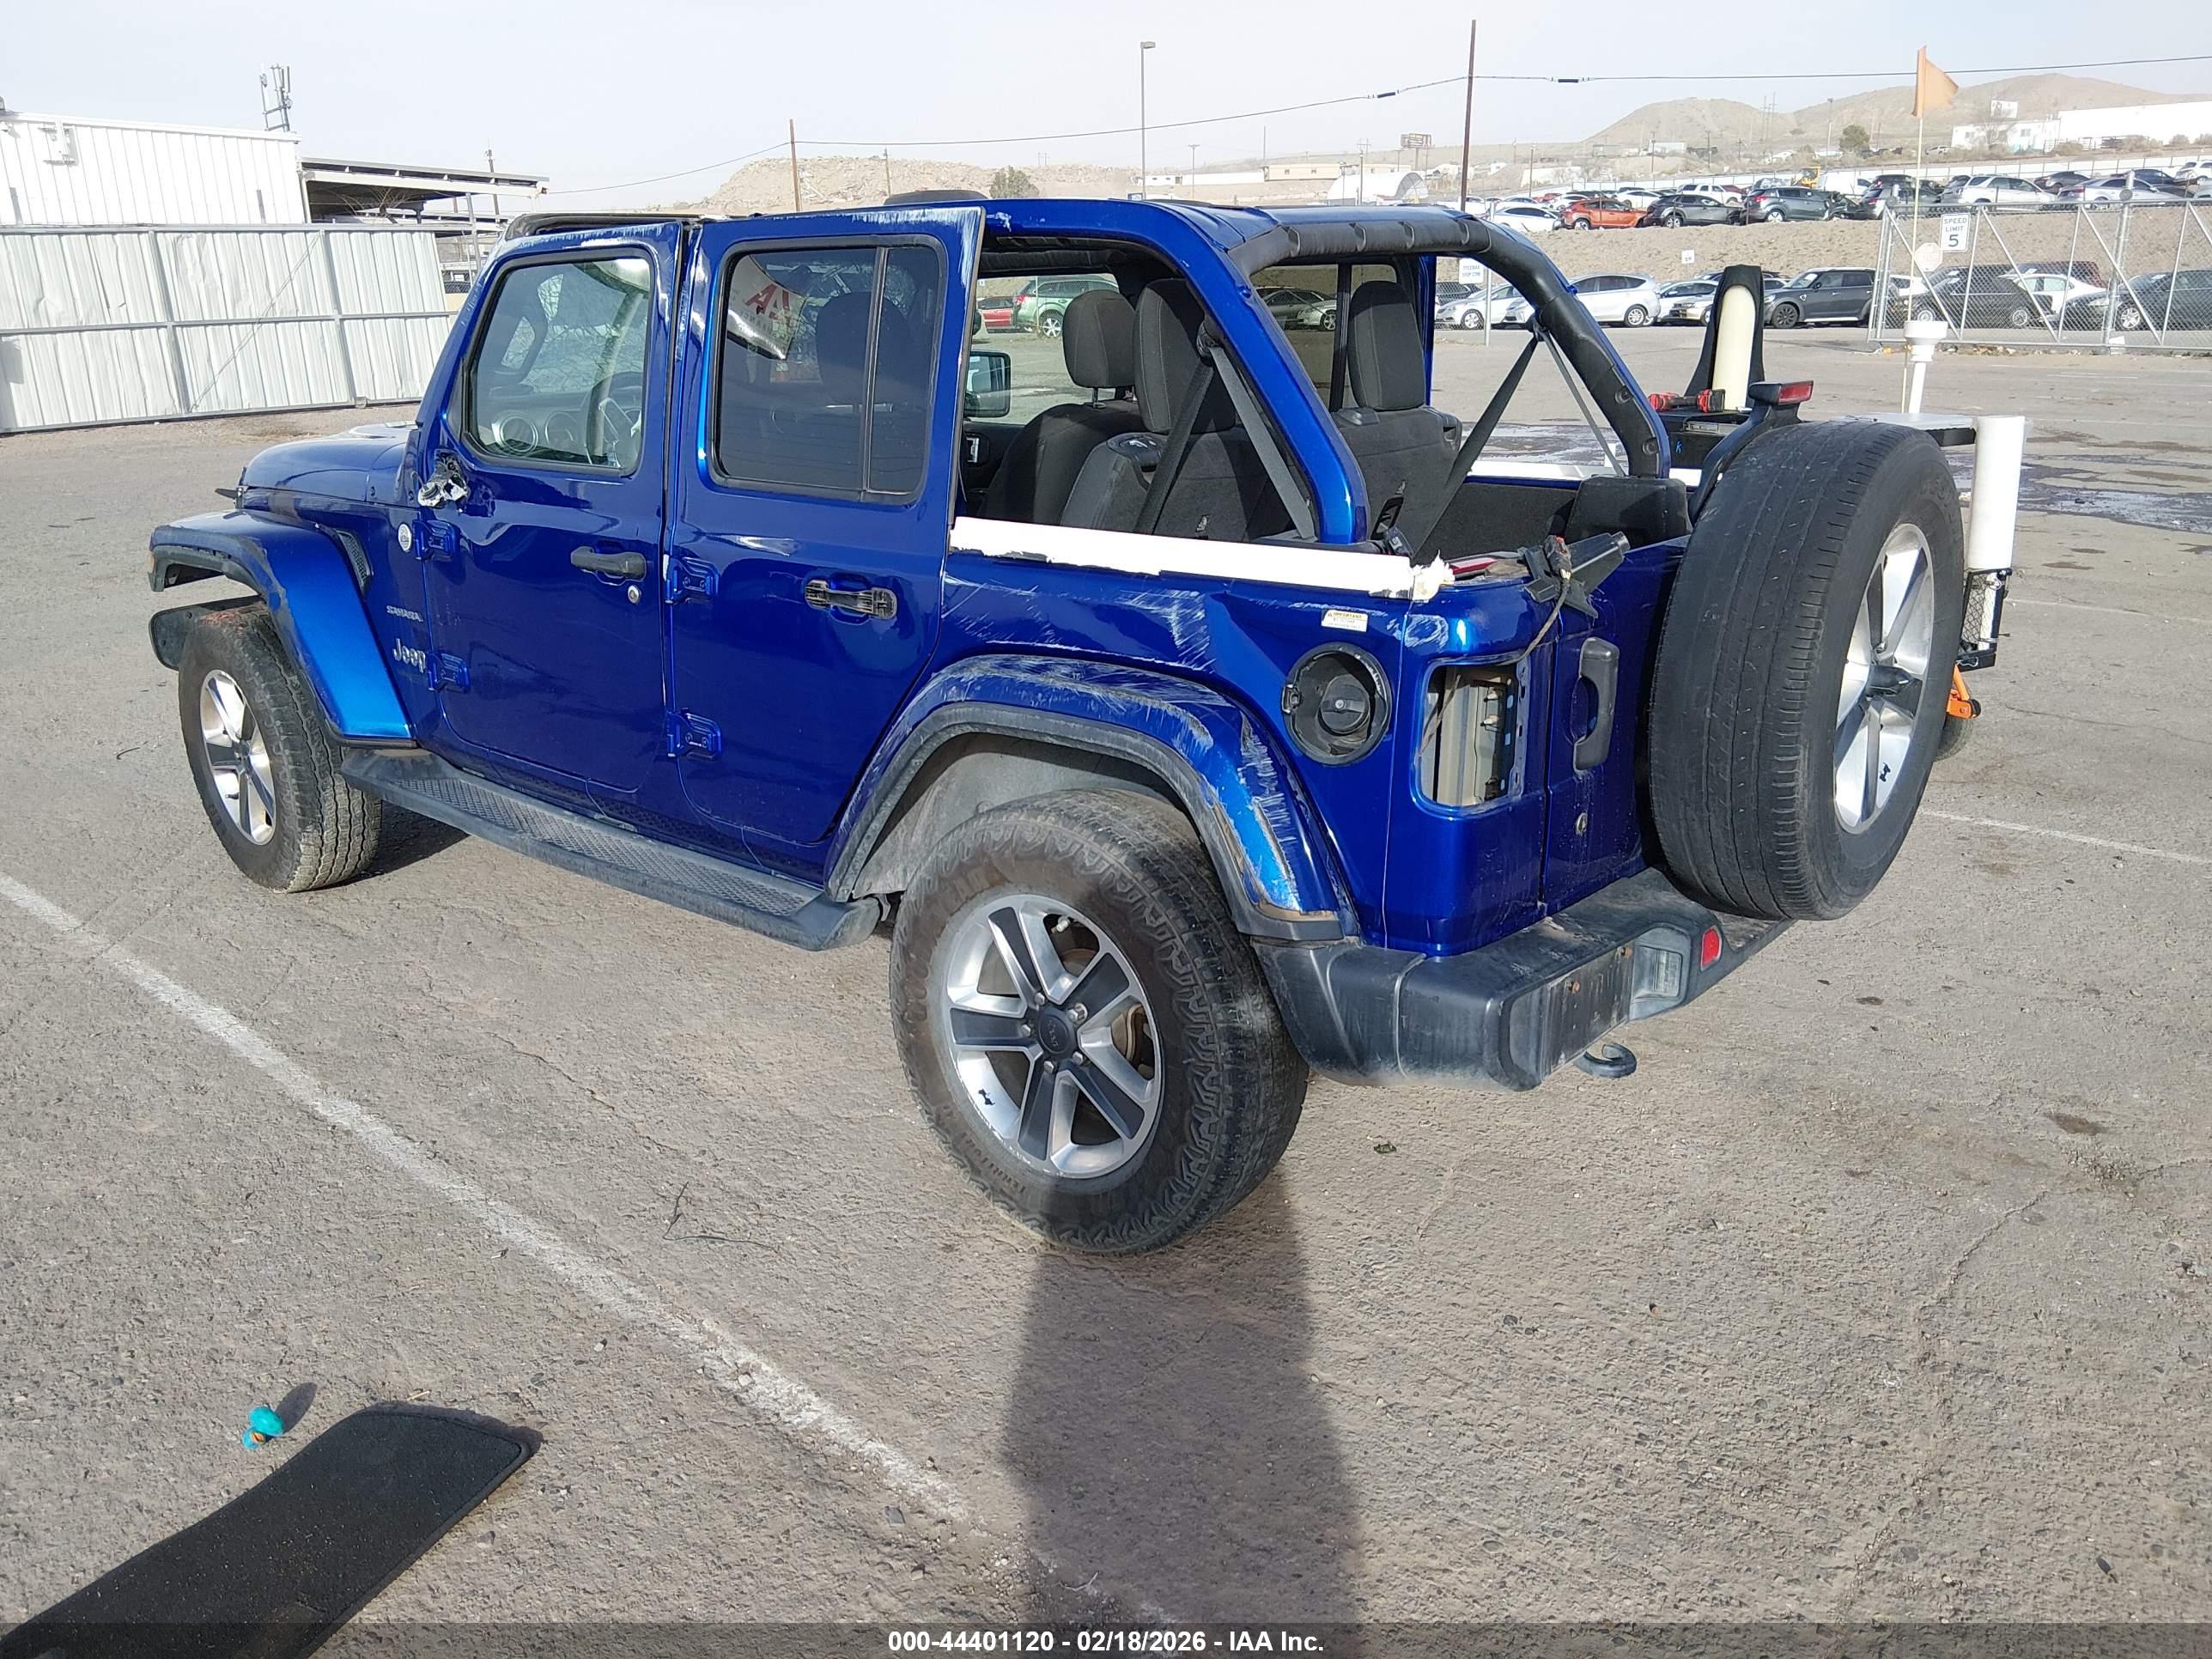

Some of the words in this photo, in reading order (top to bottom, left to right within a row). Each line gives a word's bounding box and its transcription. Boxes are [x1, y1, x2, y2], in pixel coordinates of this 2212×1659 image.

[1948, 234, 1959, 247] 5
[386, 605, 424, 623] SAHARA
[392, 638, 427, 674] Jeep
